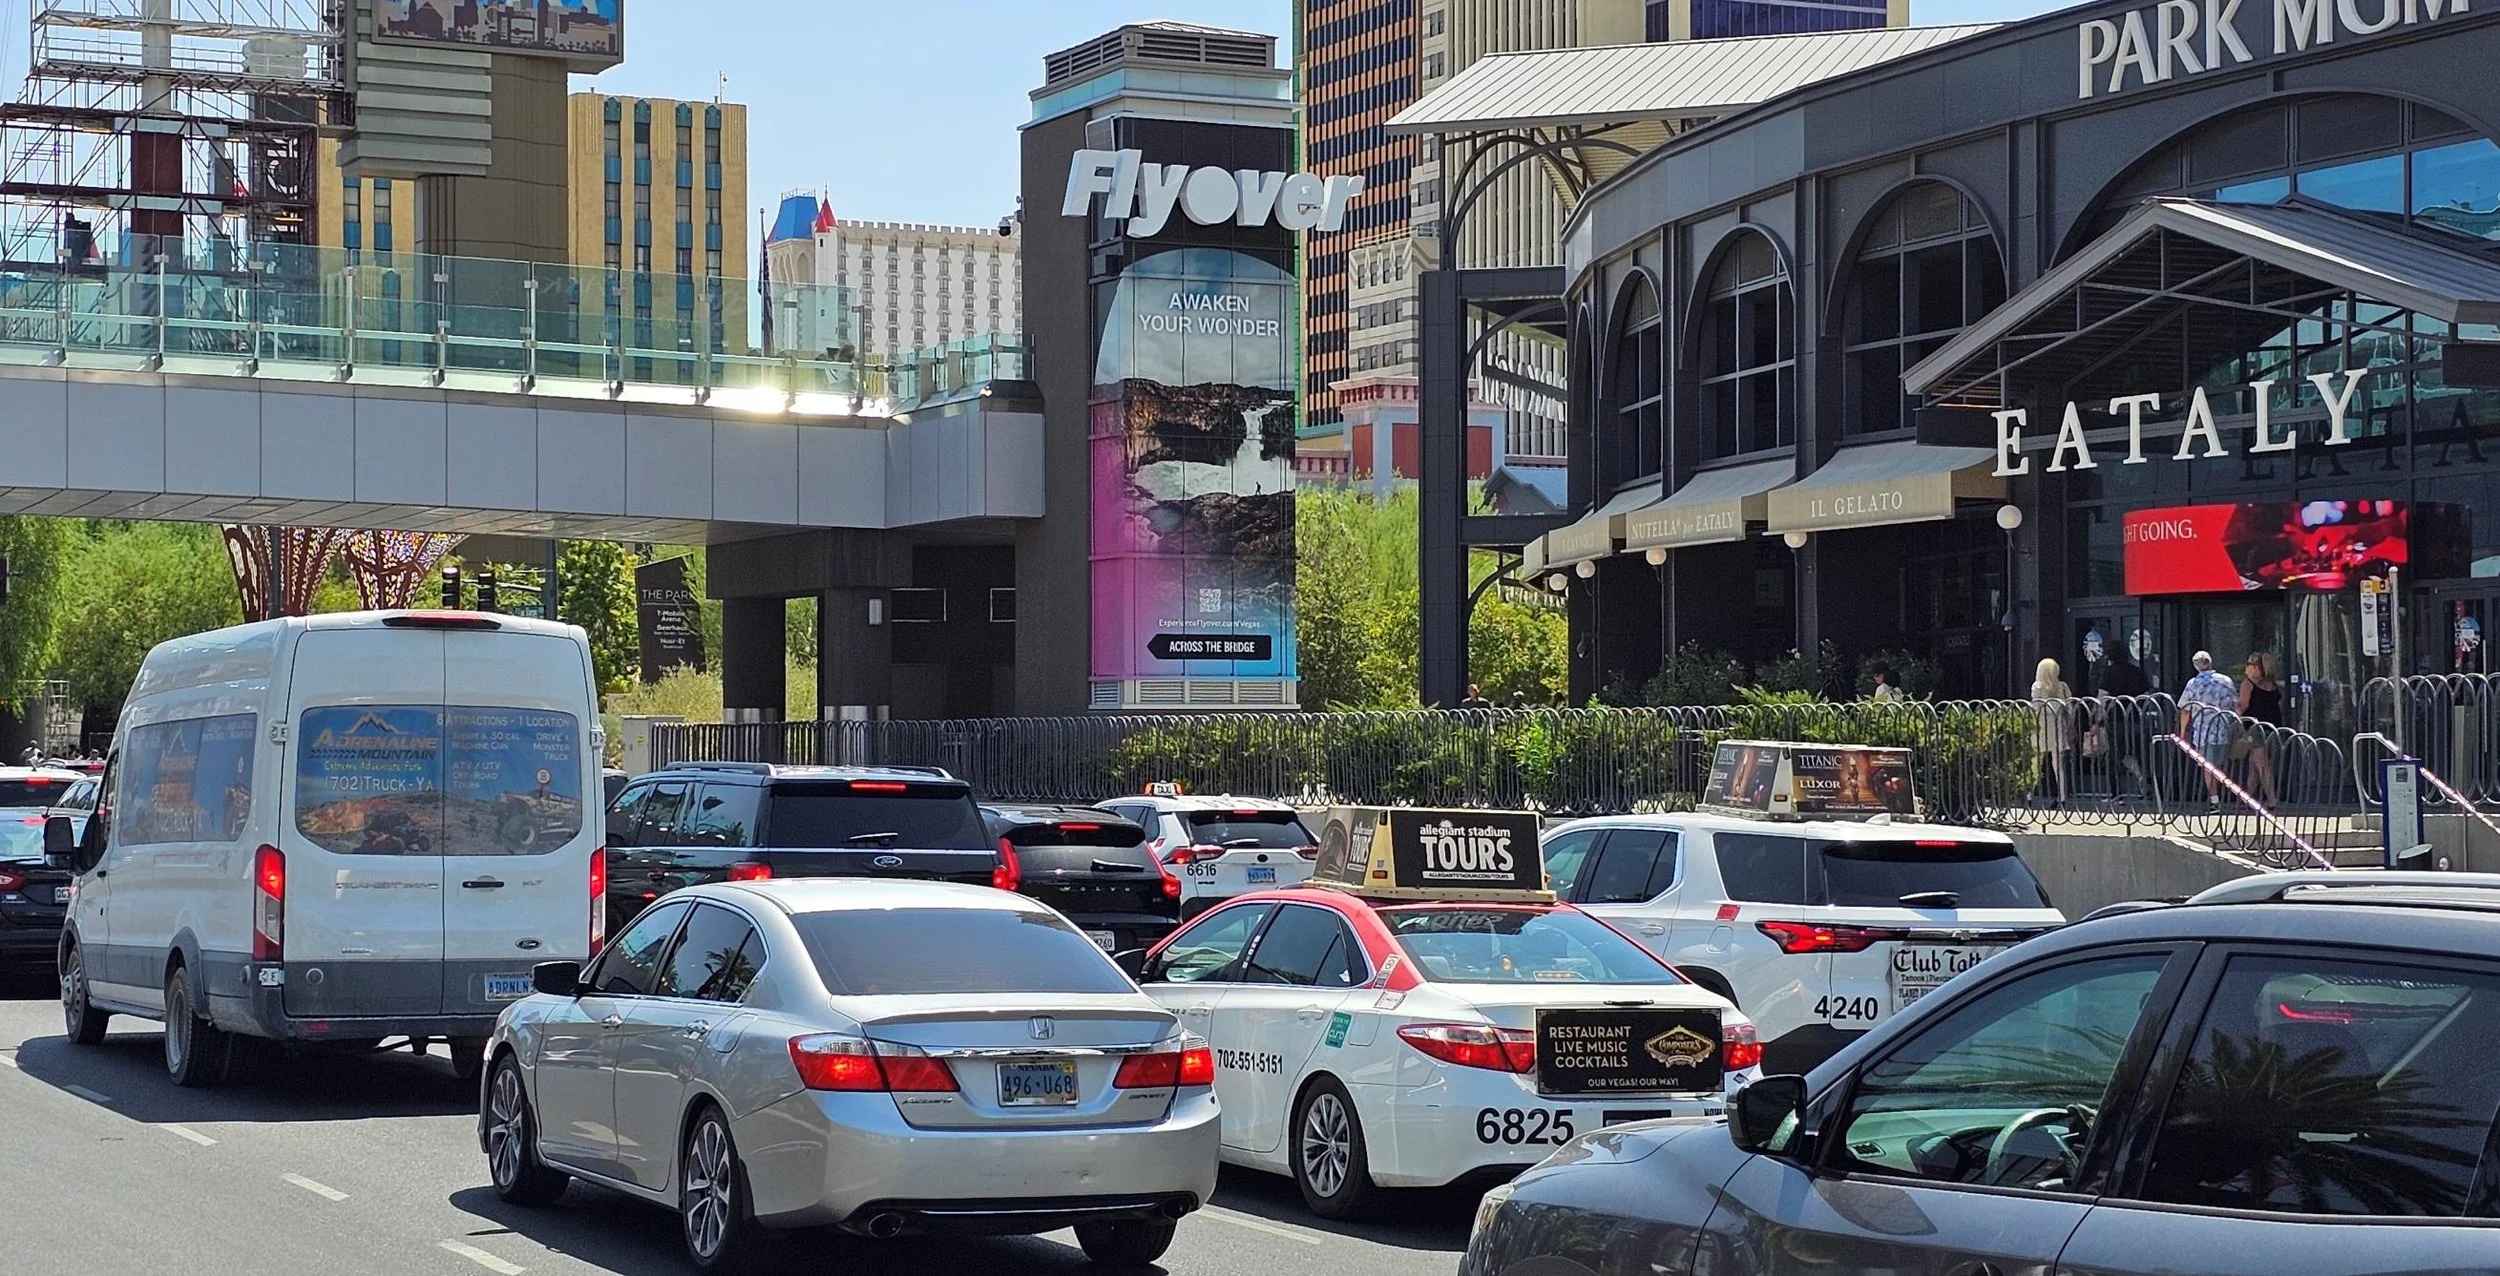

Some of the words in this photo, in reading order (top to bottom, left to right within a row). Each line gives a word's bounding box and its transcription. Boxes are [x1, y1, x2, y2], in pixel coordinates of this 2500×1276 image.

[2078, 0, 2254, 98] PARK
[1061, 148, 1366, 238] Flyover
[1169, 293, 1249, 312] AWAKEN
[1139, 315, 1192, 333] YOUR
[1198, 317, 1280, 337] WONDER
[1991, 368, 2368, 477] EATALY
[1811, 500, 1828, 517] IL
[1834, 491, 1903, 514] GELATO
[1696, 511, 1735, 532] EATALY
[2140, 519, 2198, 542] GOING.
[641, 589, 663, 600] THE
[1169, 641, 1203, 653] ACROSS
[1205, 641, 1222, 653] THE
[1224, 641, 1255, 653] BRIDGE
[526, 716, 570, 727] LOCATION
[356, 749, 437, 760] MOUNTAIN
[1798, 754, 1842, 767] TITANIC
[1157, 785, 1172, 794] TAXI
[1800, 780, 1841, 789] LUXOR
[1420, 824, 1465, 838] allegiant
[1468, 825, 1511, 837] stadium
[1420, 836, 1514, 871] TOURS
[1187, 864, 1217, 877] 6616
[1893, 949, 1941, 972] Club
[1814, 995, 1879, 1021] 4240
[1549, 1026, 1631, 1039] RESTAURANT
[1555, 1041, 1584, 1053] LIVE
[1586, 1041, 1628, 1053] MUSIC
[1217, 1049, 1283, 1075] 702-551-5151
[1555, 1056, 1628, 1068] COCKTAILS
[1588, 1078, 1606, 1087] OUR
[1608, 1078, 1638, 1087] VEGAS!
[1639, 1078, 1657, 1087] OUR
[1659, 1077, 1679, 1087] WAY!
[1475, 1107, 1574, 1145] 6825
